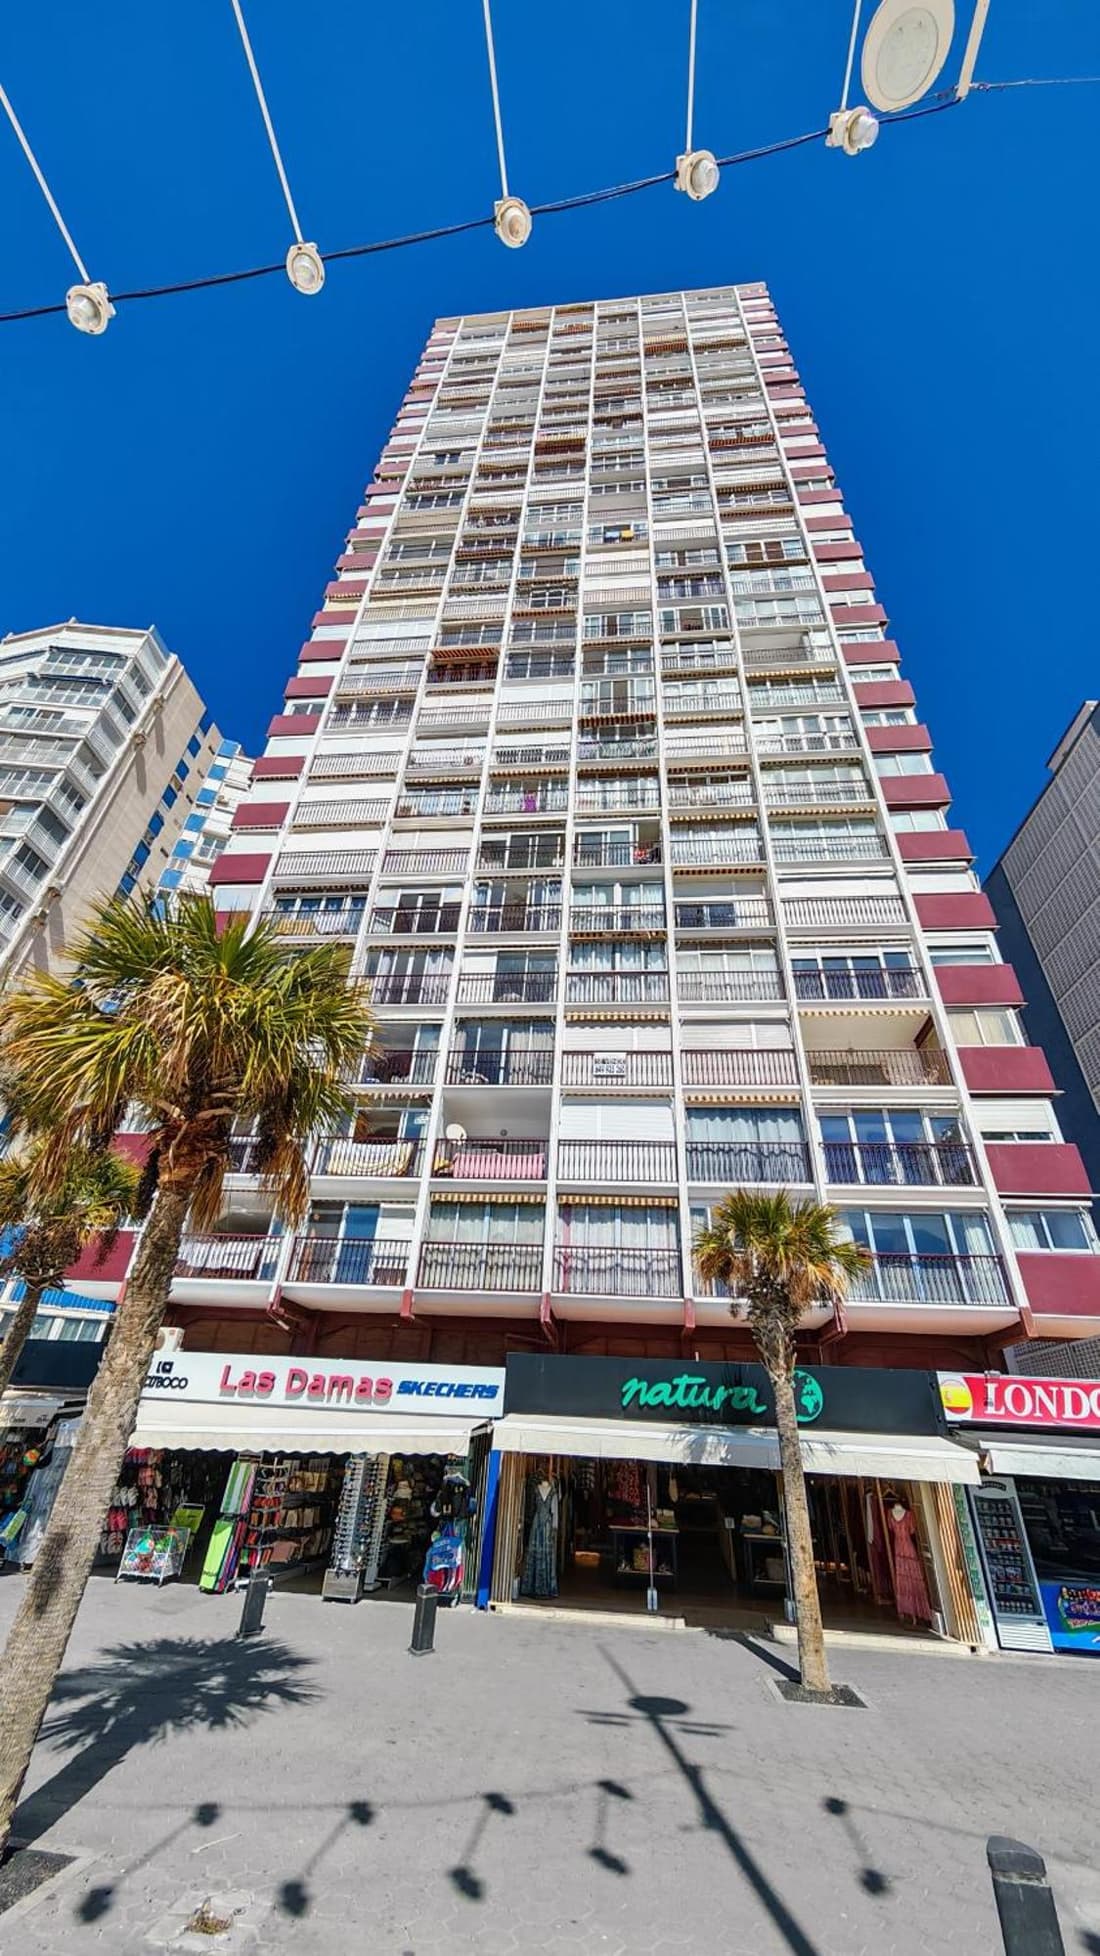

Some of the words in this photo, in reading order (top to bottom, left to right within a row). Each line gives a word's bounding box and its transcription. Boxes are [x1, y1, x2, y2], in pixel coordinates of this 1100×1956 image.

[219, 1365, 276, 1393] Las
[285, 1368, 393, 1400] Damas
[396, 1380, 500, 1399] SKECHERS
[621, 1373, 768, 1414] natura
